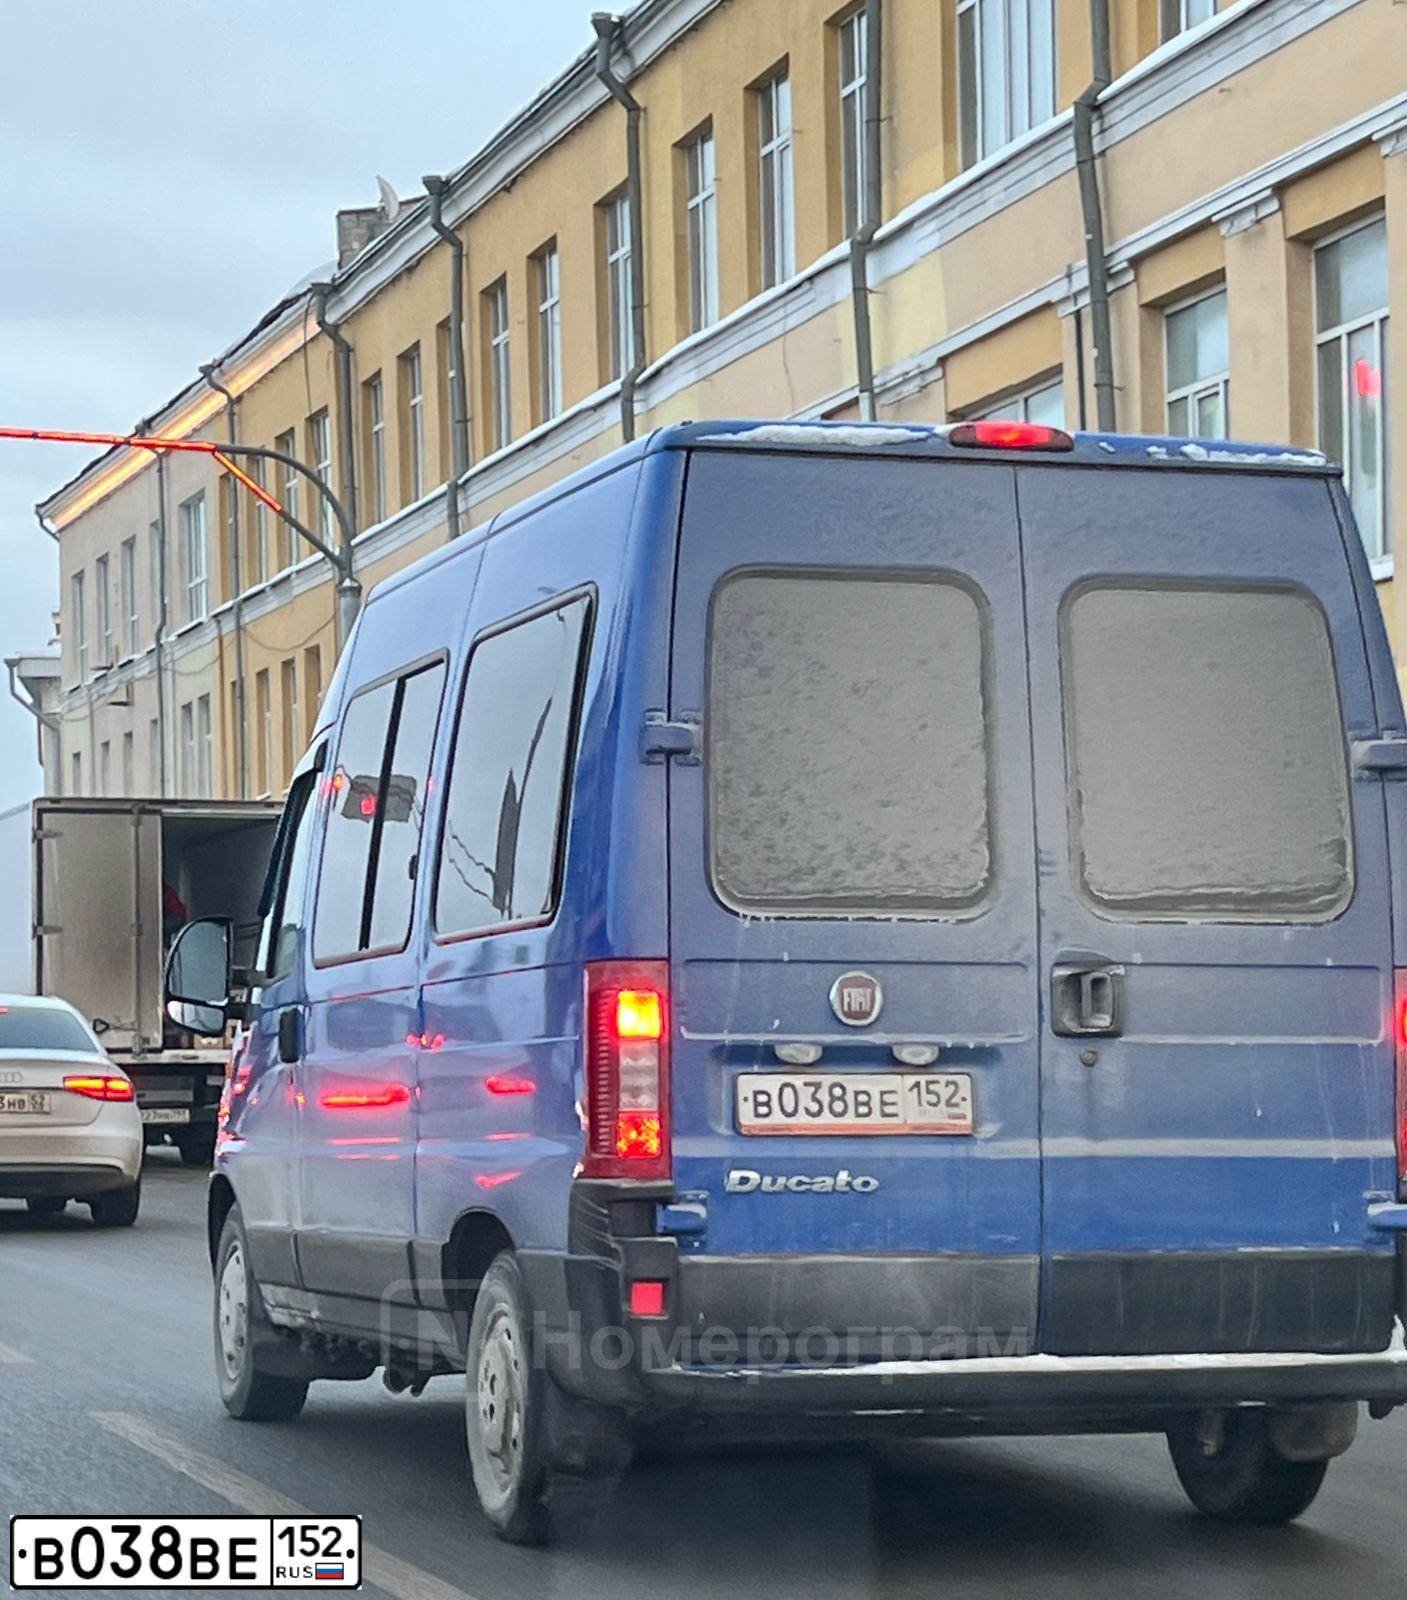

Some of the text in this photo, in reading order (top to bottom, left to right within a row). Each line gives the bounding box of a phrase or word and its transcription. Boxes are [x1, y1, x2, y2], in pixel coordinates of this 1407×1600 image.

[843, 987, 873, 1012] FIAT
[753, 1079, 960, 1118] В038ВЕ 152
[725, 1169, 879, 1193] Ducato
